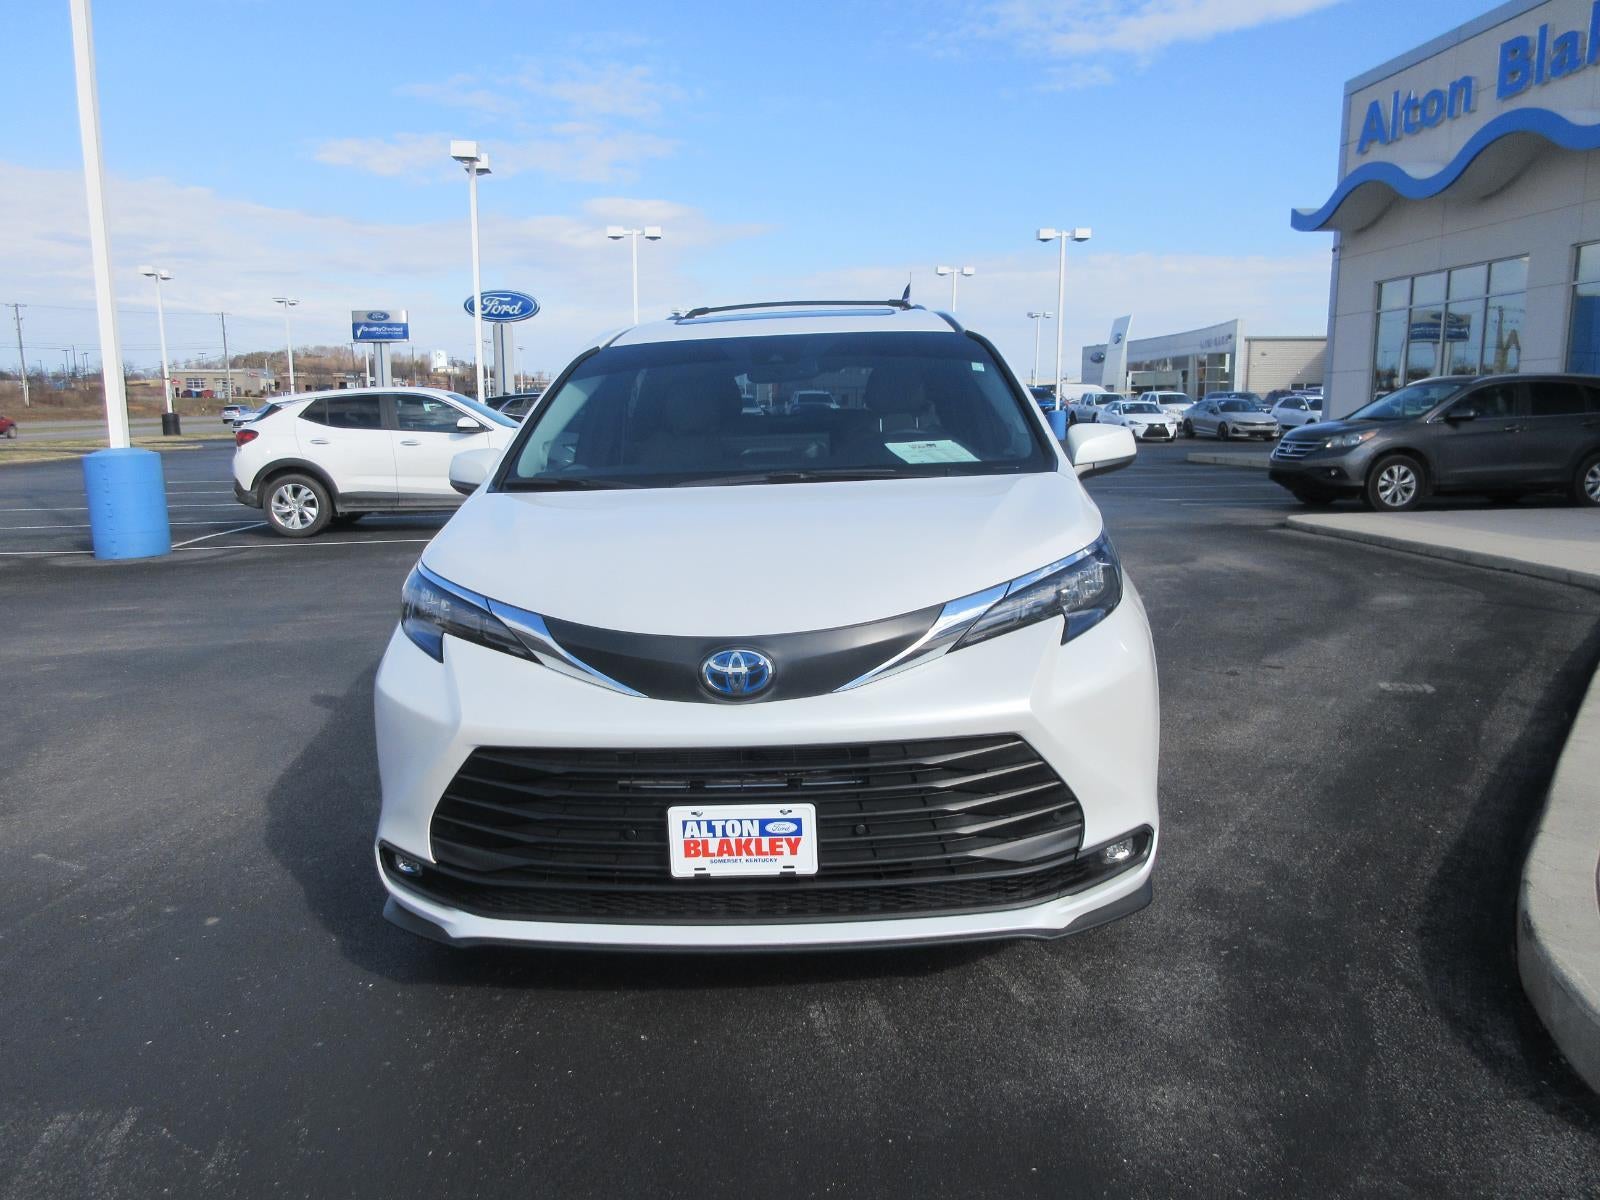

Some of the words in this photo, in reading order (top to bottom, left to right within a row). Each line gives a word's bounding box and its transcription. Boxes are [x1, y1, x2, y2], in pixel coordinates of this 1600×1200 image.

[1356, 75, 1474, 155] Alton
[481, 296, 522, 314] Ford
[684, 820, 760, 838] ALTON
[684, 838, 801, 858] BLAKLEY
